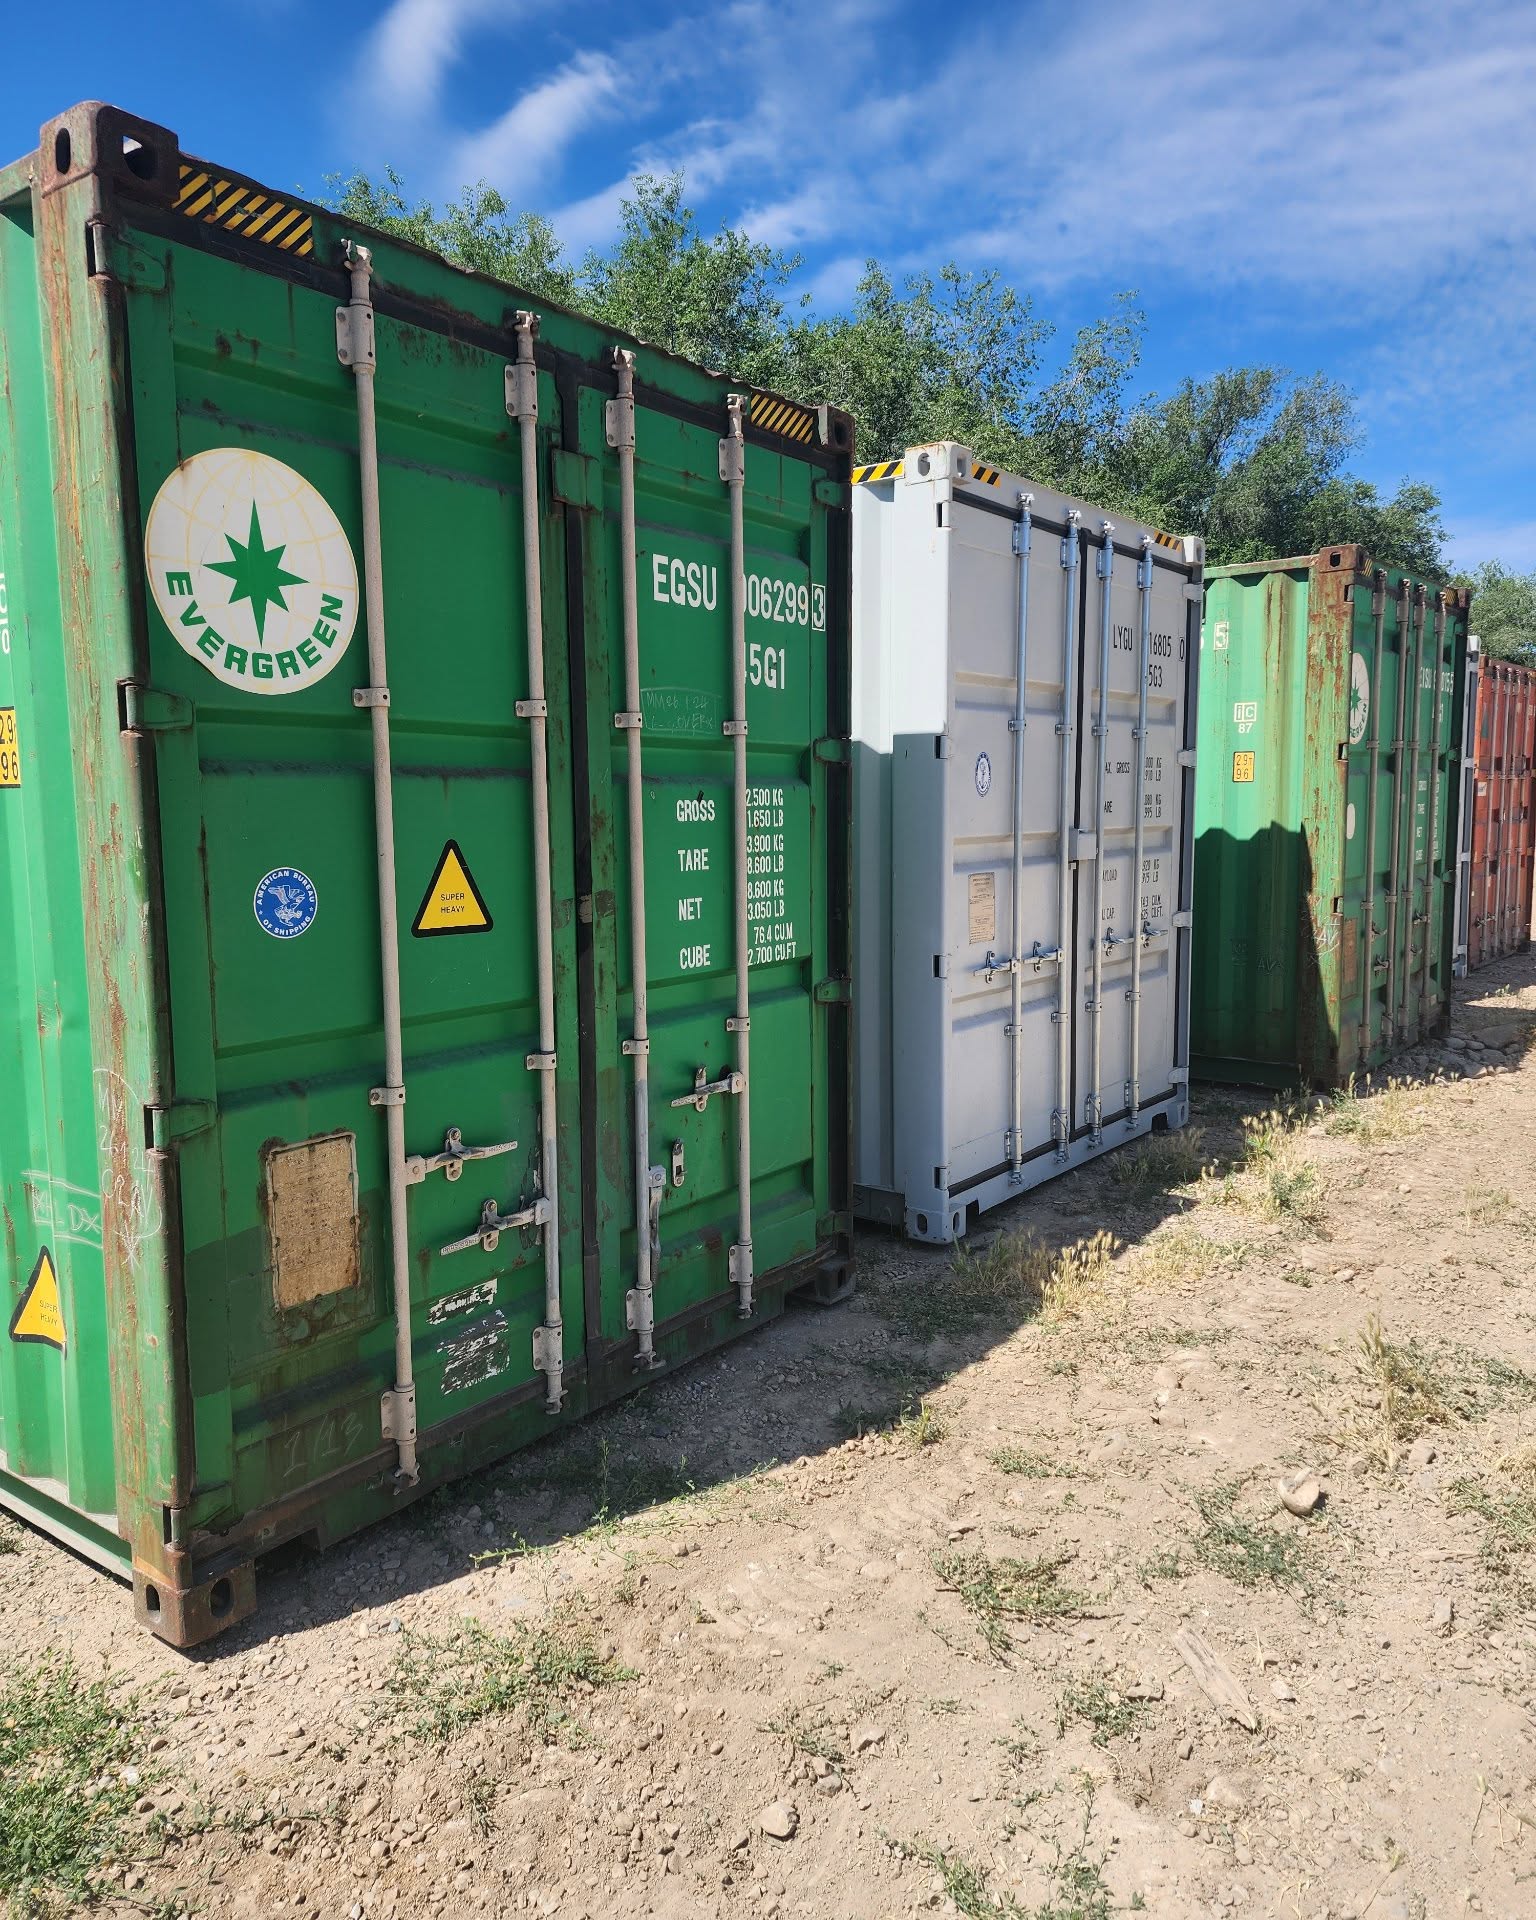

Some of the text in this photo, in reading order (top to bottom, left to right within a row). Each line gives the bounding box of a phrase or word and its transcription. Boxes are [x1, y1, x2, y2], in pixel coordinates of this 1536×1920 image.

[652, 553, 717, 611] EGSU
[813, 587, 825, 629] 3
[165, 571, 344, 679] EVERGREEN
[1113, 624, 1133, 651] LYGU
[1149, 632, 1172, 657] 16805
[743, 642, 785, 690] 5G1
[1148, 664, 1163, 687] 5G3
[1238, 723, 1253, 734] 87
[1, 751, 19, 781] 96
[1155, 770, 1162, 781] LB
[1236, 769, 1249, 780] 96
[772, 788, 784, 806] KG
[676, 799, 715, 822] GROSS
[1103, 801, 1113, 813] ARE
[1155, 806, 1162, 818] LB
[773, 809, 784, 827] LB
[746, 834, 784, 853] 3.900 KG
[677, 848, 709, 872] TARE
[747, 855, 784, 875] 8.600 LB
[1102, 869, 1118, 881] AYLOAD
[256, 870, 315, 905] AMERICAN BUREAU
[440, 892, 465, 901] SUPER
[773, 879, 784, 897] KG
[440, 905, 465, 914] HEAVY
[678, 897, 703, 922] NET
[774, 900, 785, 918] LB
[262, 916, 311, 936] OF SHIPPING
[753, 922, 793, 945] 76.4 CU.M
[679, 944, 711, 970] CUBE
[774, 942, 797, 961] CU.FT
[39, 1299, 58, 1314] SUPER
